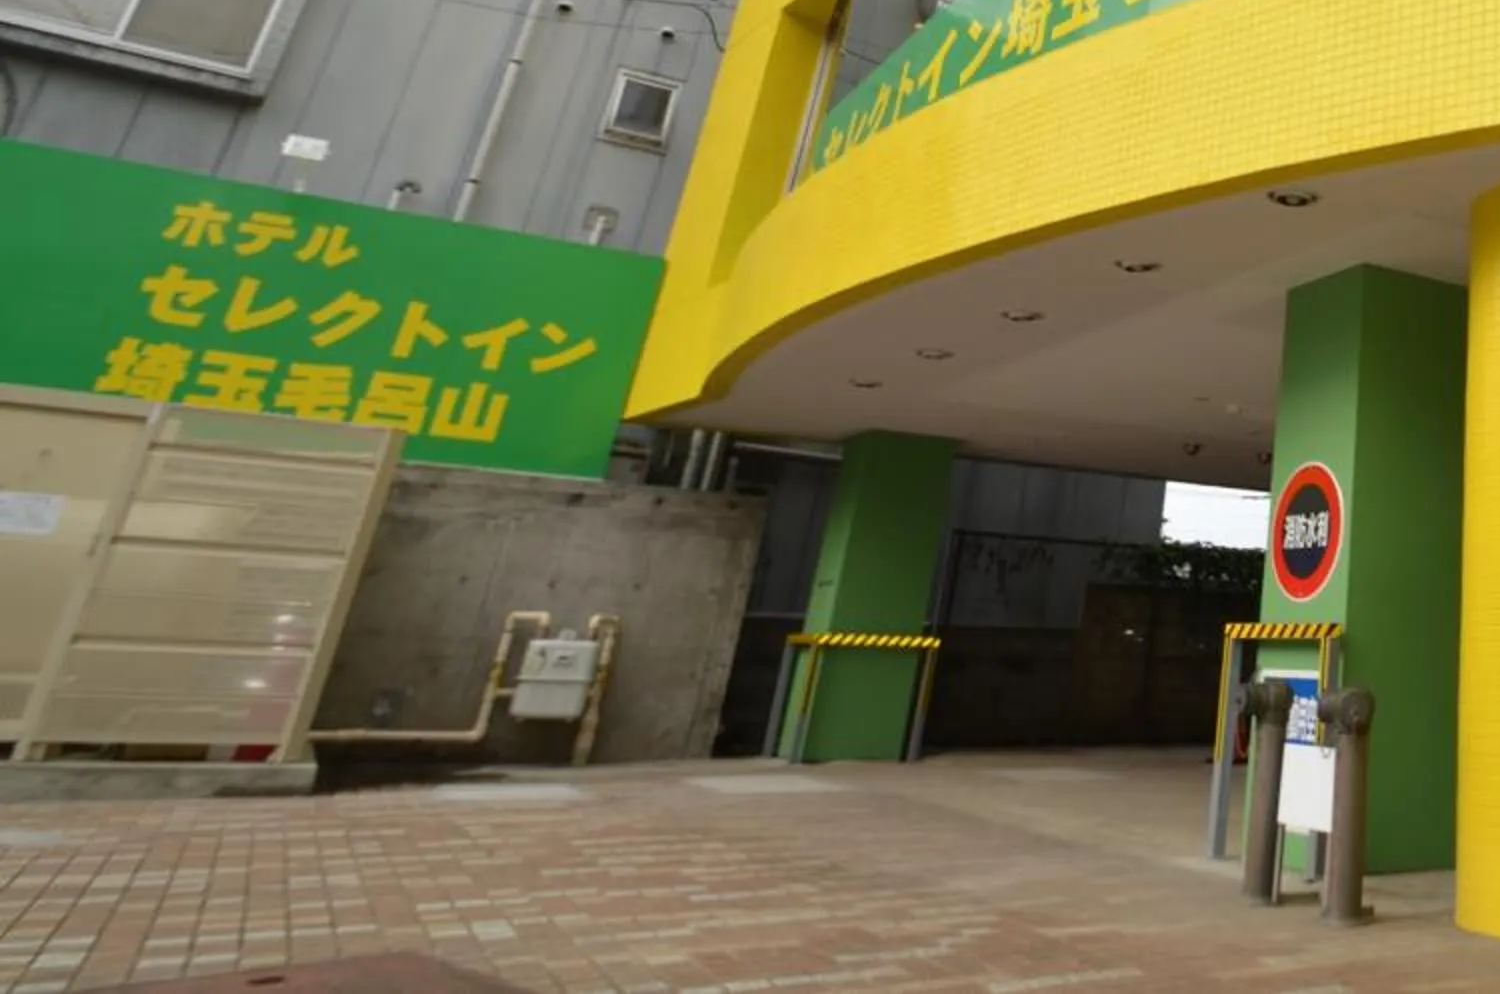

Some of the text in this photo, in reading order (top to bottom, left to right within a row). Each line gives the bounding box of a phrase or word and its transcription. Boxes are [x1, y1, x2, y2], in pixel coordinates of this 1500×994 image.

[164, 202, 358, 267] ホテル
[142, 266, 595, 373] セレクトイン
[95, 337, 508, 442] 埼玉毛呂山
